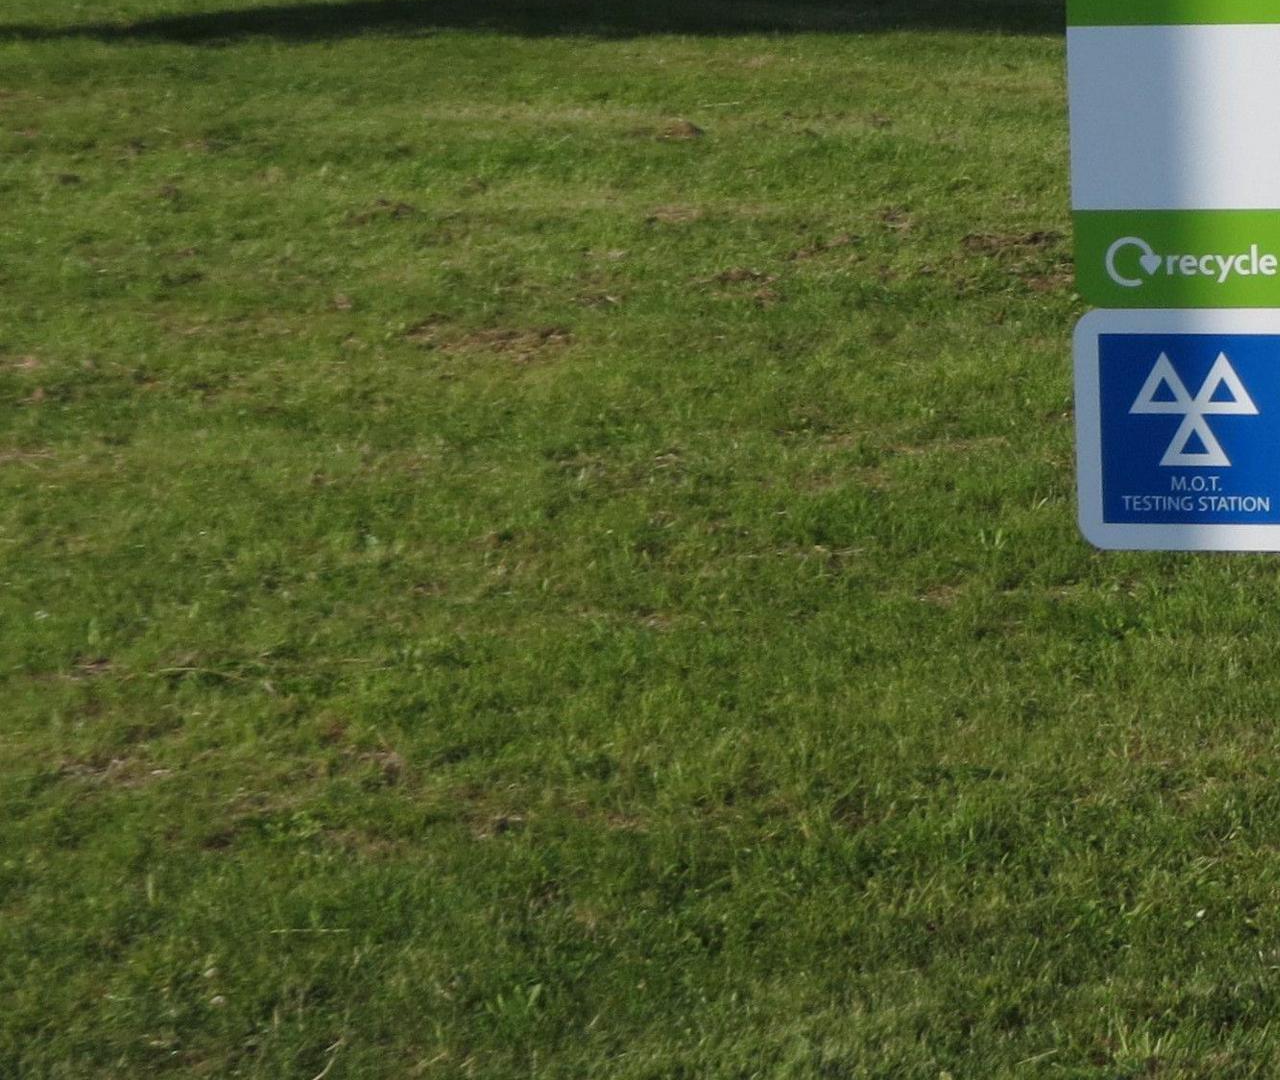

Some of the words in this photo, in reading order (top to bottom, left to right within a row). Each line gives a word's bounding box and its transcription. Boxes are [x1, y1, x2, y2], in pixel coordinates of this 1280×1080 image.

[1166, 243, 1279, 284] recycle
[1171, 475, 1223, 492] M.O.T.
[1121, 495, 1194, 512] TESTING
[1198, 495, 1270, 512] STATION
